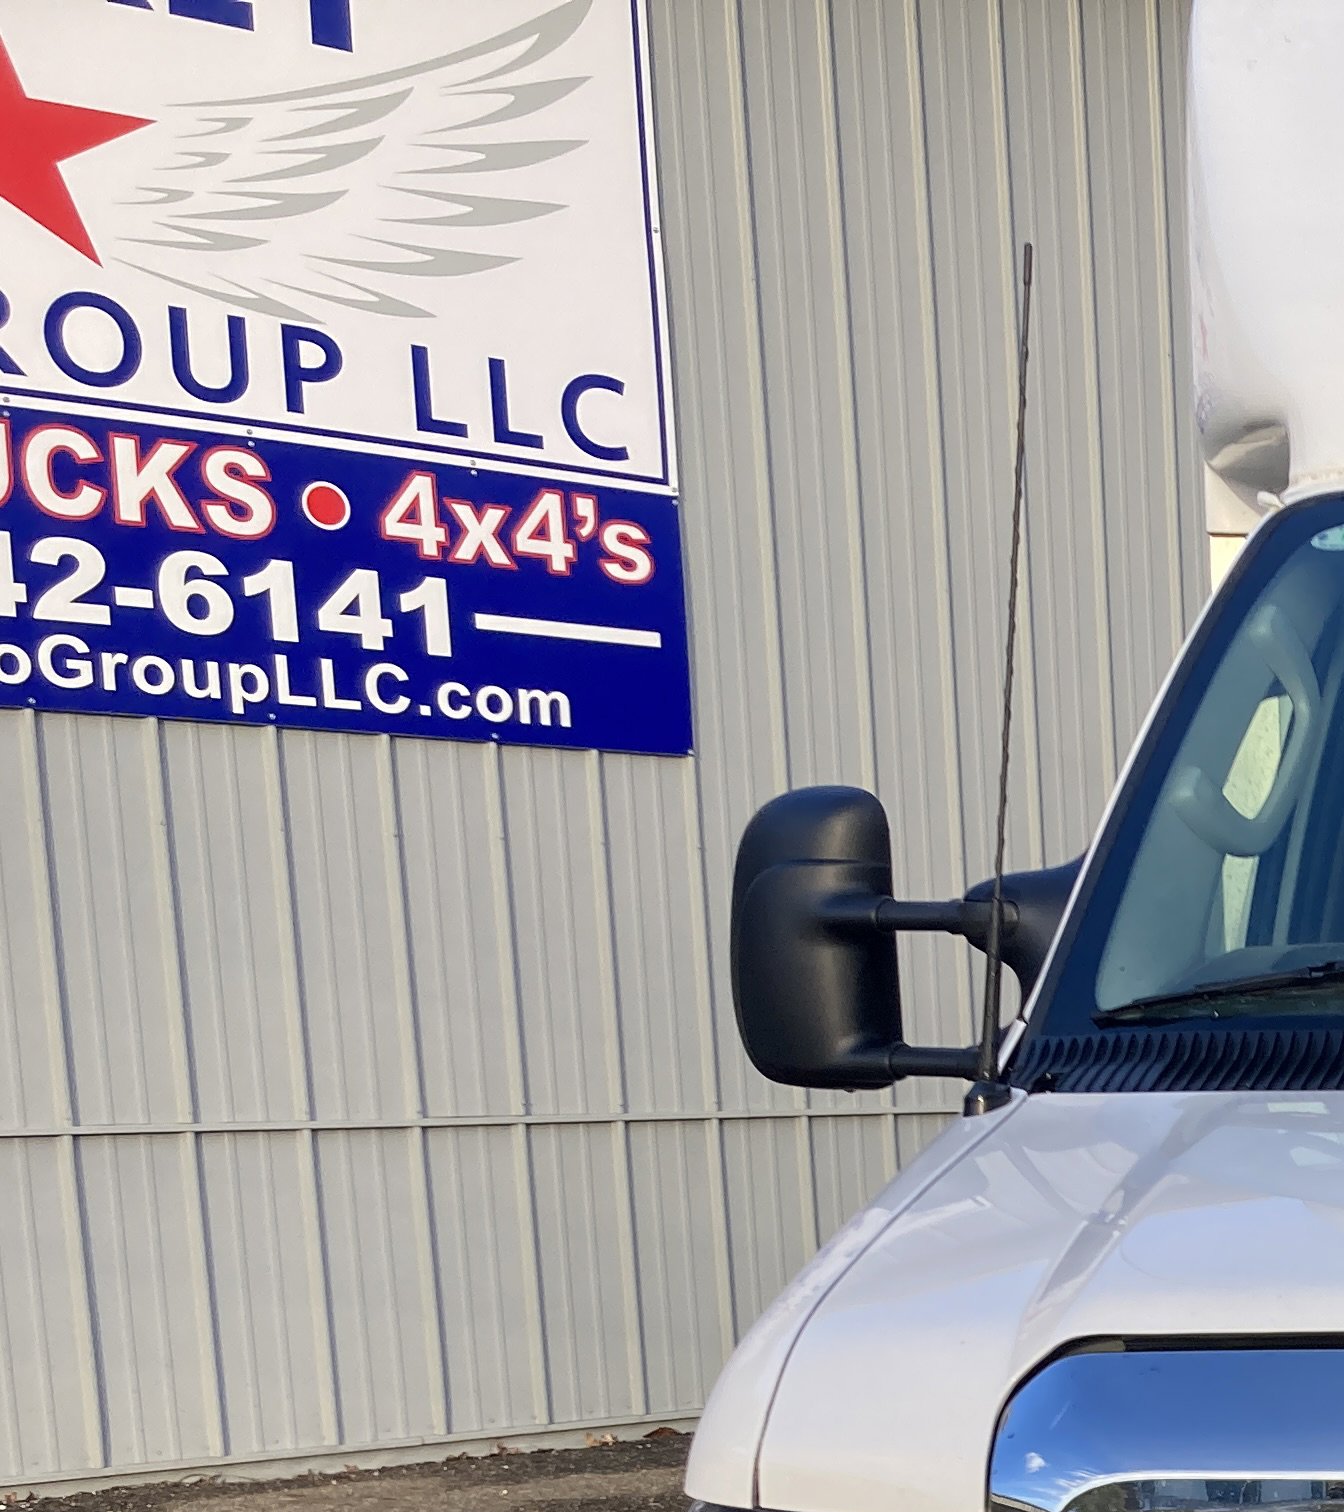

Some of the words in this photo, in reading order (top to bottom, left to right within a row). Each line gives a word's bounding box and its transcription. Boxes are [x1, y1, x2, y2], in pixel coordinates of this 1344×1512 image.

[411, 344, 629, 462] LLC
[0, 417, 277, 540] CKS
[380, 471, 655, 585] 4x4's
